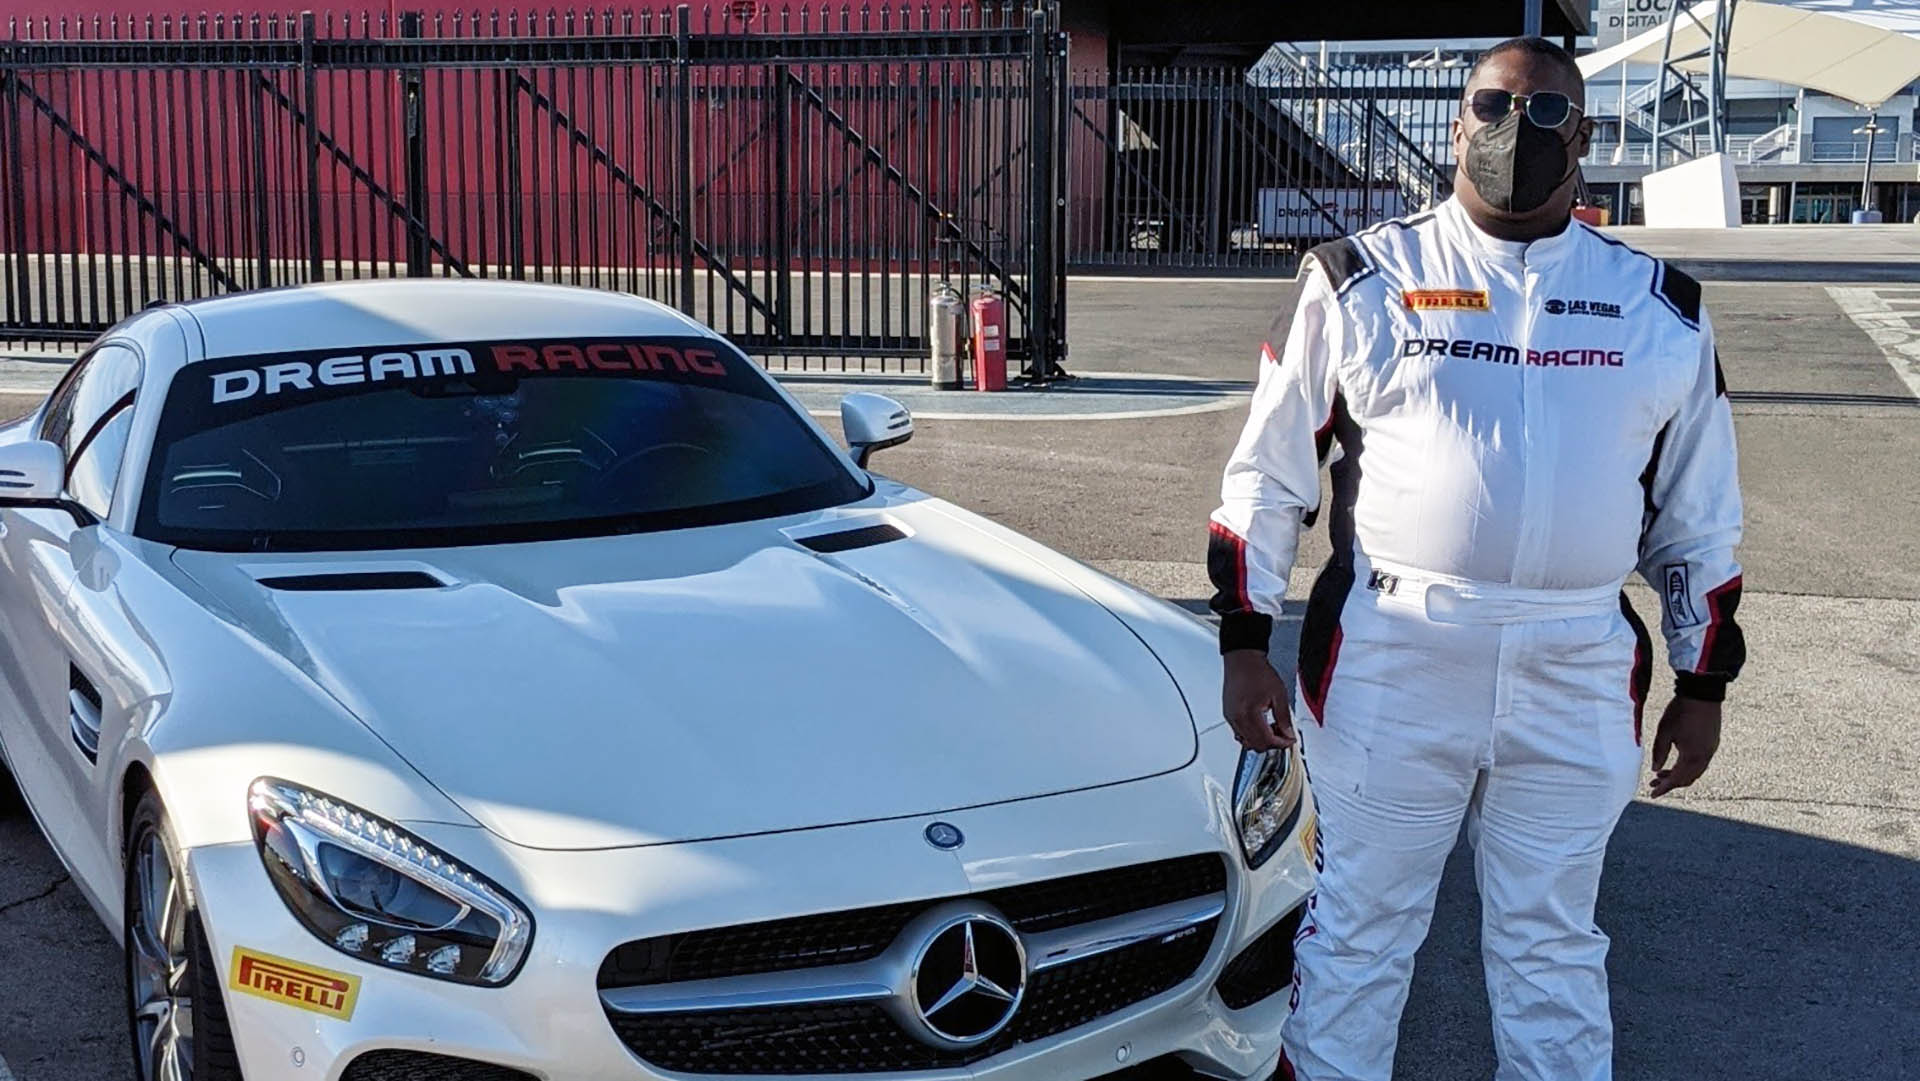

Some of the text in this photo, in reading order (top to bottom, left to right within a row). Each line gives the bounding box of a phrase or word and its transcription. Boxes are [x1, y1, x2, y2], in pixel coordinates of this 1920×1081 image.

[1627, 0, 1673, 12] LOC
[1568, 300, 1621, 314] LAS VEGAS
[1403, 338, 1624, 367] DREAM RACING
[209, 344, 727, 404] DREAM RACING
[238, 954, 349, 1011] PIRELLI
